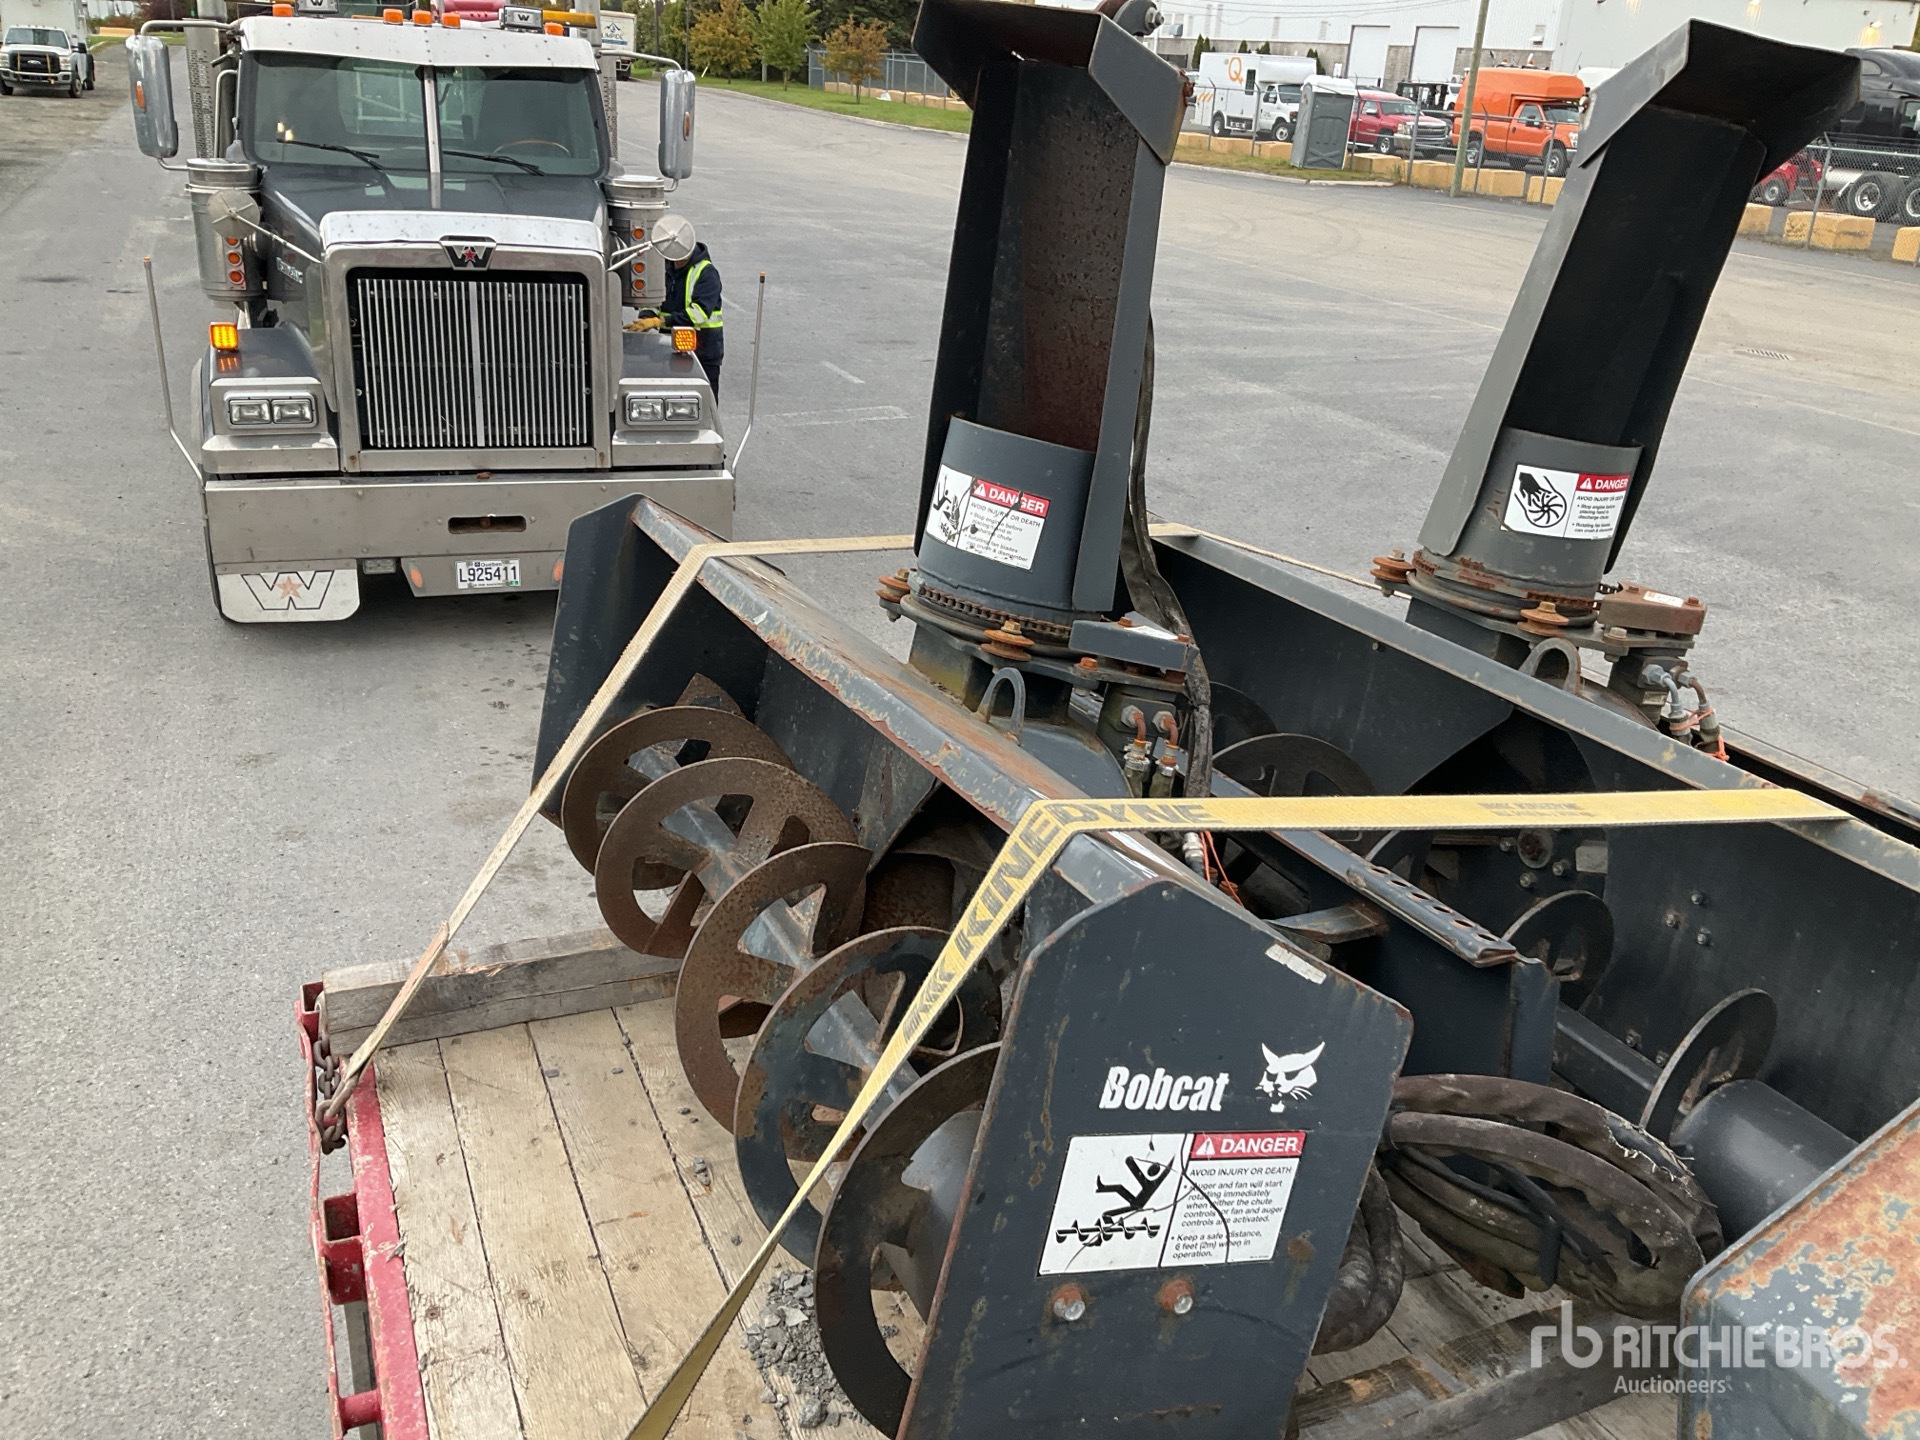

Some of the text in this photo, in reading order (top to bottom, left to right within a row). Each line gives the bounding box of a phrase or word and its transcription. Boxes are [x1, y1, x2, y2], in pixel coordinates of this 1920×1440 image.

[518, 13, 530, 21] W
[1595, 478, 1628, 490] DANGER
[989, 487, 1045, 514] DANGER
[1006, 523, 1022, 532] before
[1021, 517, 1040, 528] DEATH
[459, 566, 516, 582] L925411
[1099, 1066, 1229, 1111] Bobcat
[1220, 1137, 1298, 1154] DANGER
[1182, 1218, 1213, 1227] controls
[1173, 1251, 1212, 1260] operation.
